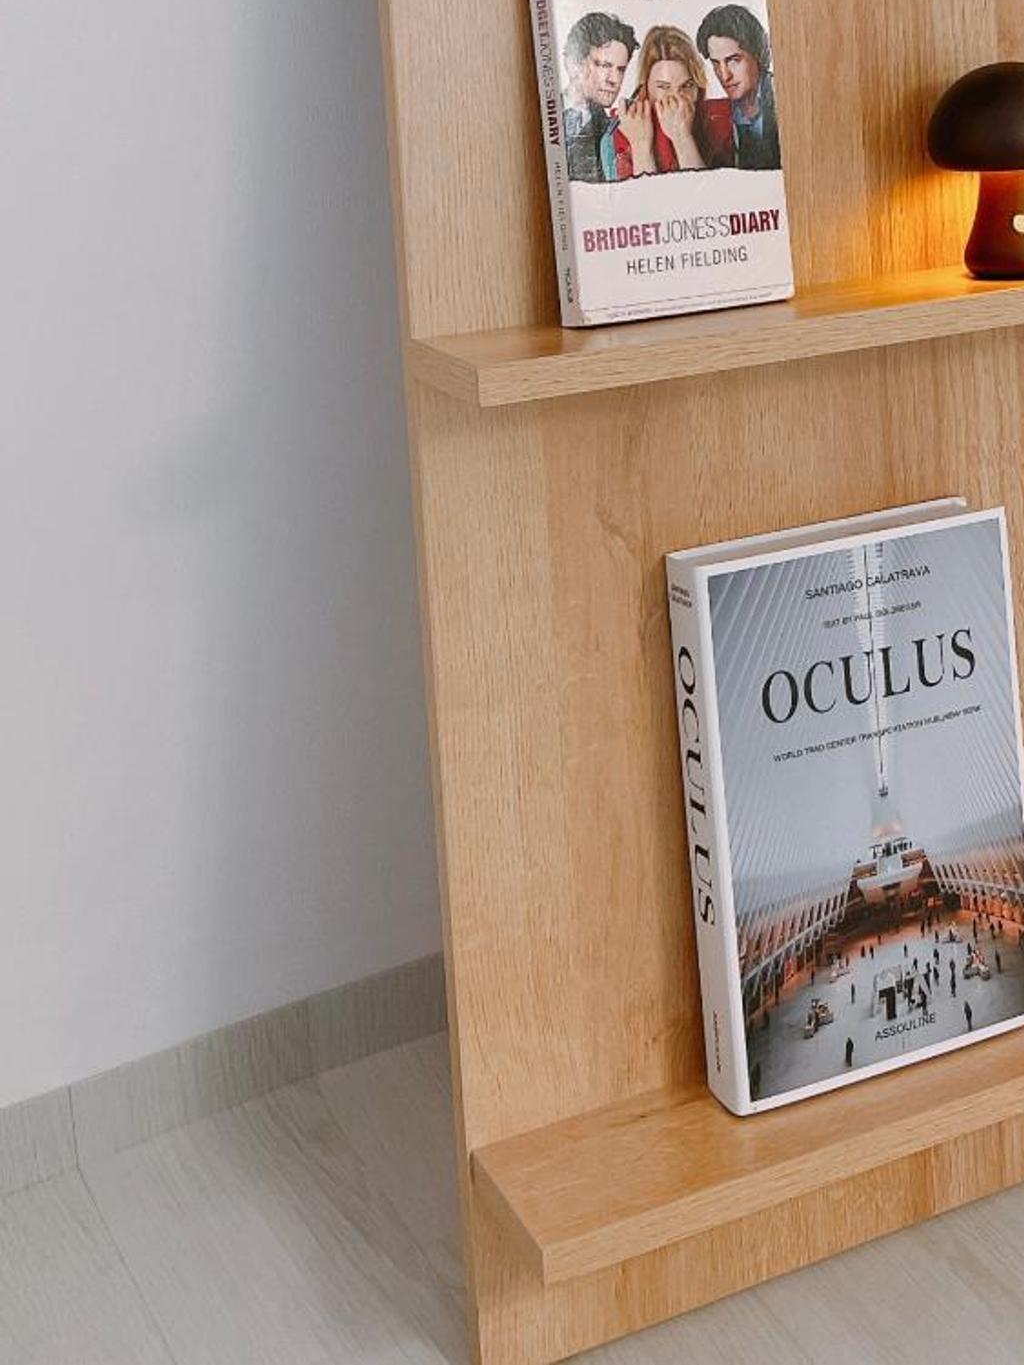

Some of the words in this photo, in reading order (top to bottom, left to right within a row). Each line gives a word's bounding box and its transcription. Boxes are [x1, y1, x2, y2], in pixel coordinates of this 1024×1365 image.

[626, 255, 675, 276] HELEN
[681, 245, 748, 269] FIELDING
[805, 579, 863, 601] SANTIAGO
[865, 565, 931, 588] CALATRAVA
[762, 628, 976, 723] OCULUS
[678, 645, 716, 927] OCULUS
[875, 1011, 937, 1042] ASSOULINE
